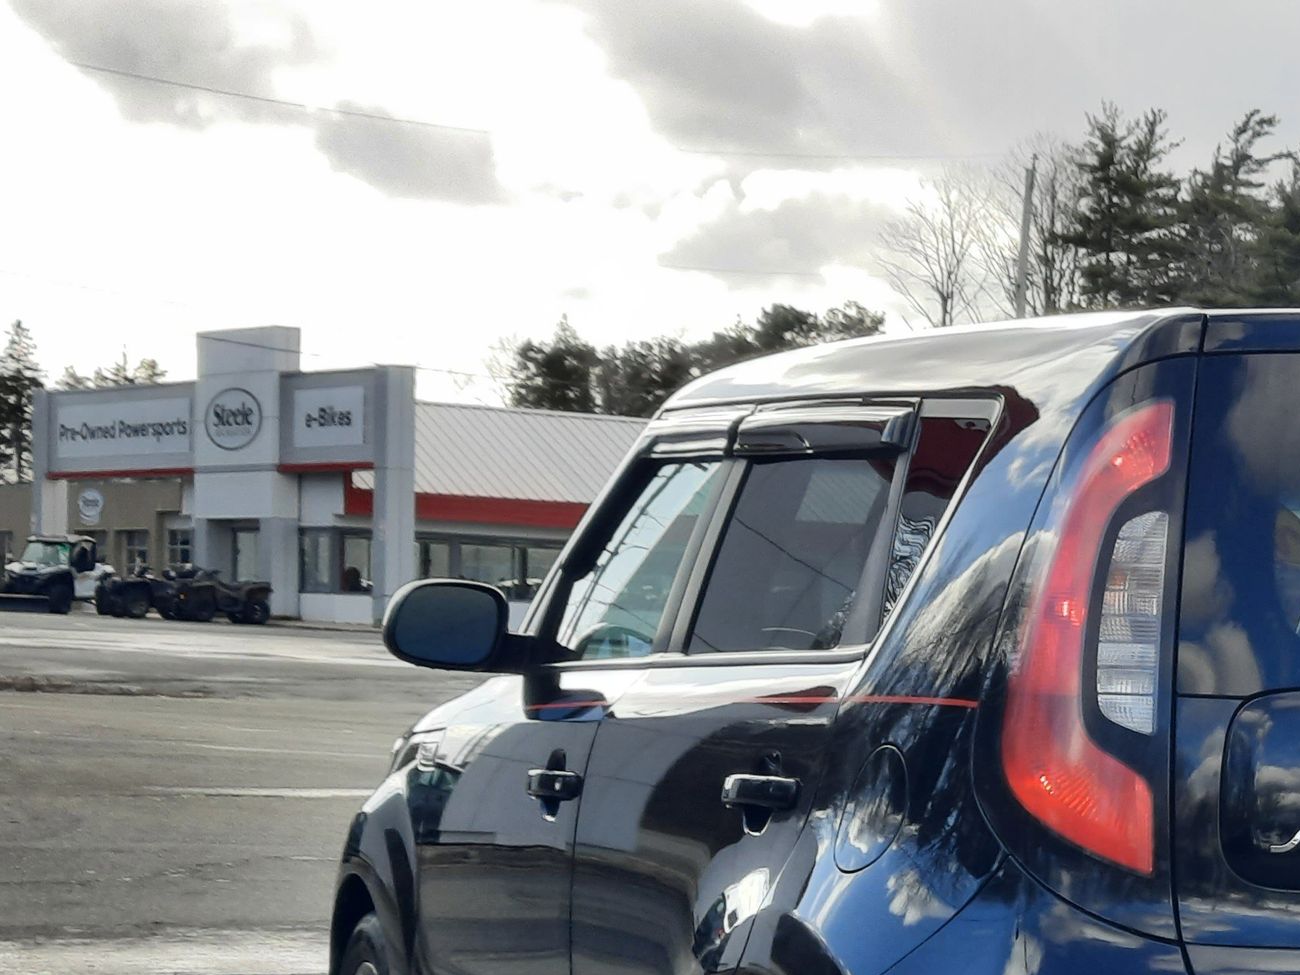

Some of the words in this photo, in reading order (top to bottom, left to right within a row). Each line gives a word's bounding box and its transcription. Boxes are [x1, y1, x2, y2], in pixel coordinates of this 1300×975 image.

[213, 402, 253, 427] Steele
[304, 406, 352, 428] e-Bikes
[59, 420, 117, 441] Pre-Owned
[118, 418, 188, 441] Powersports
